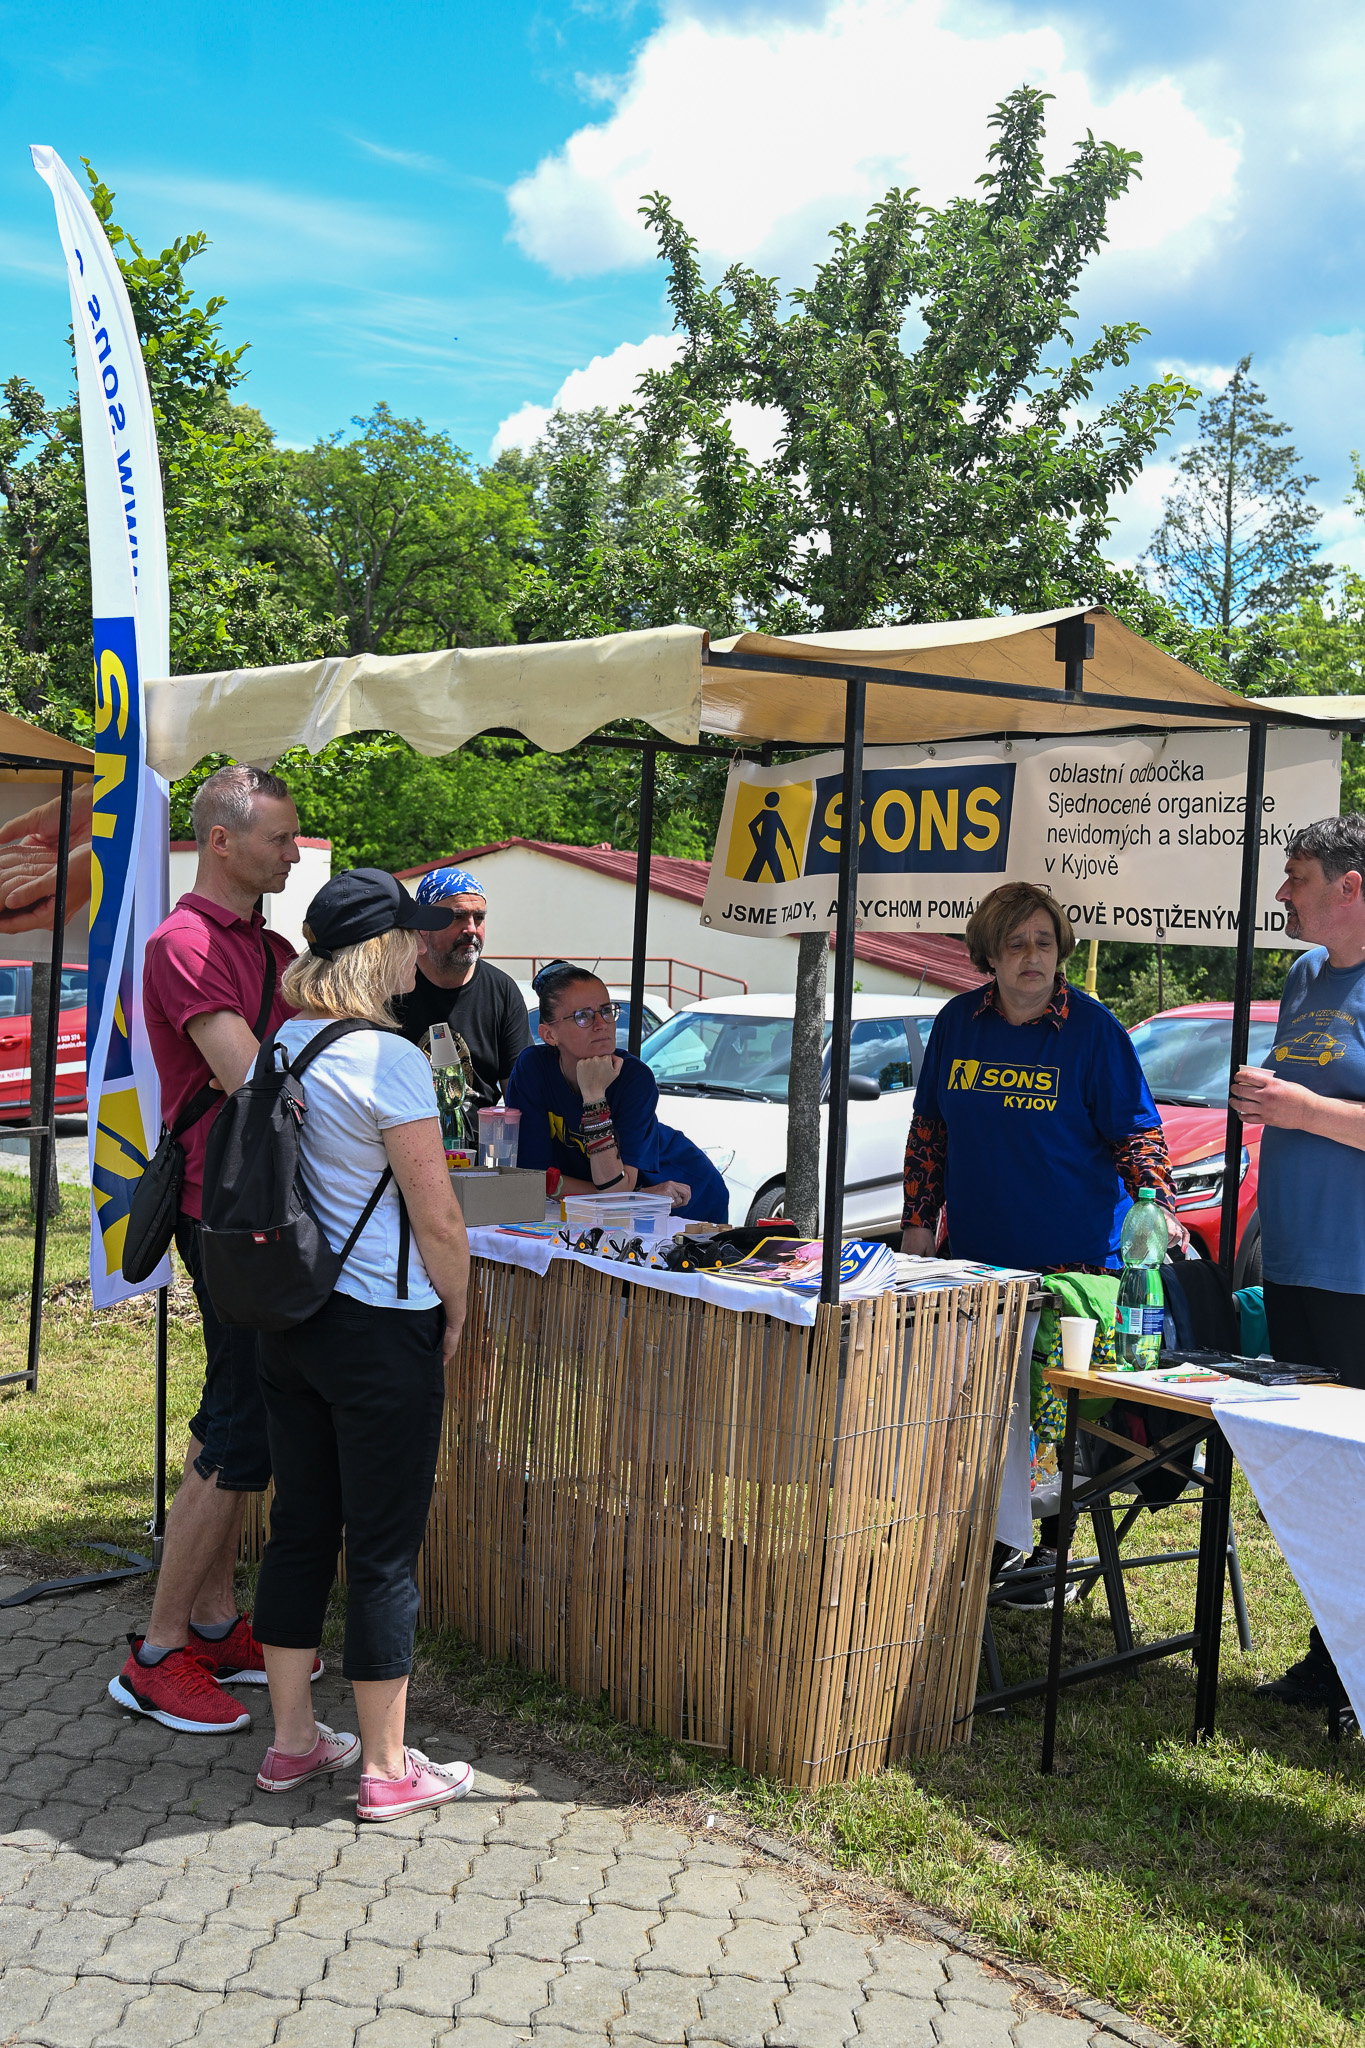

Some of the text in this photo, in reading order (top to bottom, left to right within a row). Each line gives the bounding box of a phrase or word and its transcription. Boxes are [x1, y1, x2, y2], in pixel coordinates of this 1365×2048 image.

[1049, 760, 1204, 784] oblastní odbočka
[1048, 791, 1275, 819] Sjednocené organizae
[819, 786, 1001, 853] SONS
[1047, 823, 1306, 850] nevidomých a slabozaký
[1044, 854, 1119, 879] v Kyjově
[721, 903, 777, 925] JSME
[781, 901, 817, 923] TADY,
[826, 900, 922, 919] AYCHOM
[981, 1069, 1052, 1091] SONS
[1003, 1095, 1057, 1112] KYJOV
